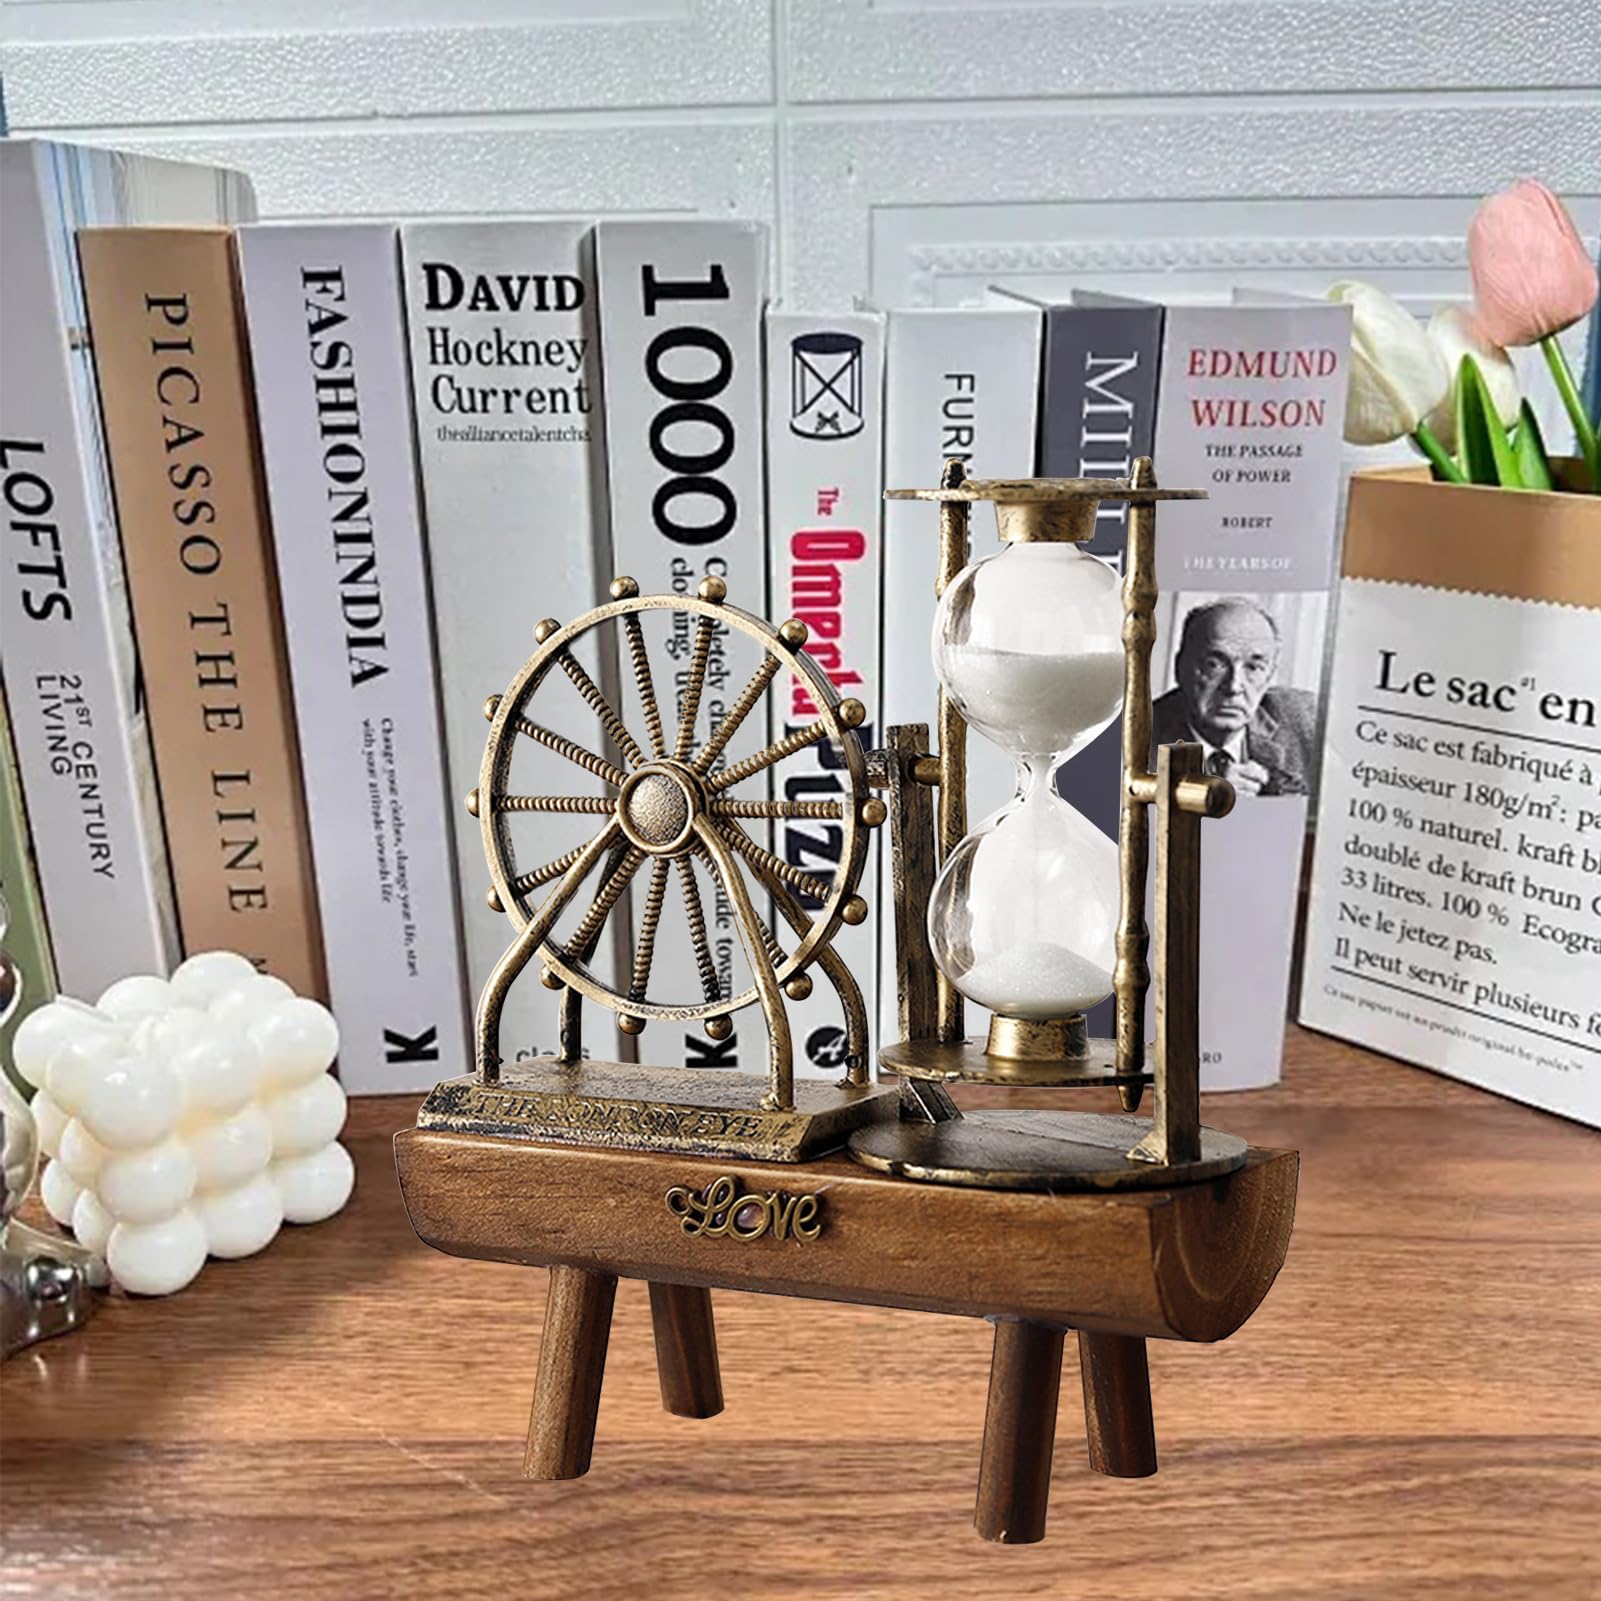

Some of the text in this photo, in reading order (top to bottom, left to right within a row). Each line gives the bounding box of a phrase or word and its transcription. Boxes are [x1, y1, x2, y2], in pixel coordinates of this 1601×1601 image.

[422, 263, 586, 312] DAVID
[429, 327, 588, 373] Hockney
[1186, 349, 1338, 379] EDMUND
[431, 374, 594, 414] Current
[642, 264, 738, 547] 1000
[1190, 399, 1327, 428] WILSON
[301, 265, 390, 688] FASHIONINDIA
[1205, 444, 1304, 458] THE PASSAGE
[1211, 469, 1292, 483] OF POWER
[0, 437, 72, 622] LOFTS
[816, 488, 839, 515] The
[145, 293, 268, 912] PICASSO THE LINE
[1374, 649, 1436, 698] Le
[1446, 676, 1517, 713] sac
[1539, 692, 1597, 728] en
[36, 674, 73, 776] LIVING
[1356, 720, 1593, 786] Ce sac est fabriqué à
[1352, 760, 1456, 798] épaisseur
[72, 740, 116, 880] CENTURY
[1349, 798, 1387, 824] 100
[1392, 807, 1413, 830] %
[1420, 819, 1508, 852] naturel.
[1517, 833, 1574, 868] kraft
[1341, 866, 1367, 890] 33
[1372, 872, 1432, 907] litres.
[1441, 890, 1481, 919] 100
[1486, 902, 1510, 926] %
[1344, 834, 1421, 871] doublé
[1427, 854, 1456, 878] de
[1460, 861, 1515, 894] kraft
[1522, 875, 1581, 911] brun
[1339, 901, 1498, 965] Ne le jetez pas.
[1336, 937, 1350, 959] Il
[1354, 948, 1402, 975] peut
[1406, 963, 1469, 995] servir
[1474, 981, 1580, 1029] plusieurs
[383, 1025, 440, 1064] K
[685, 1032, 738, 1068] K
[690, 1109, 766, 1139] EYE
